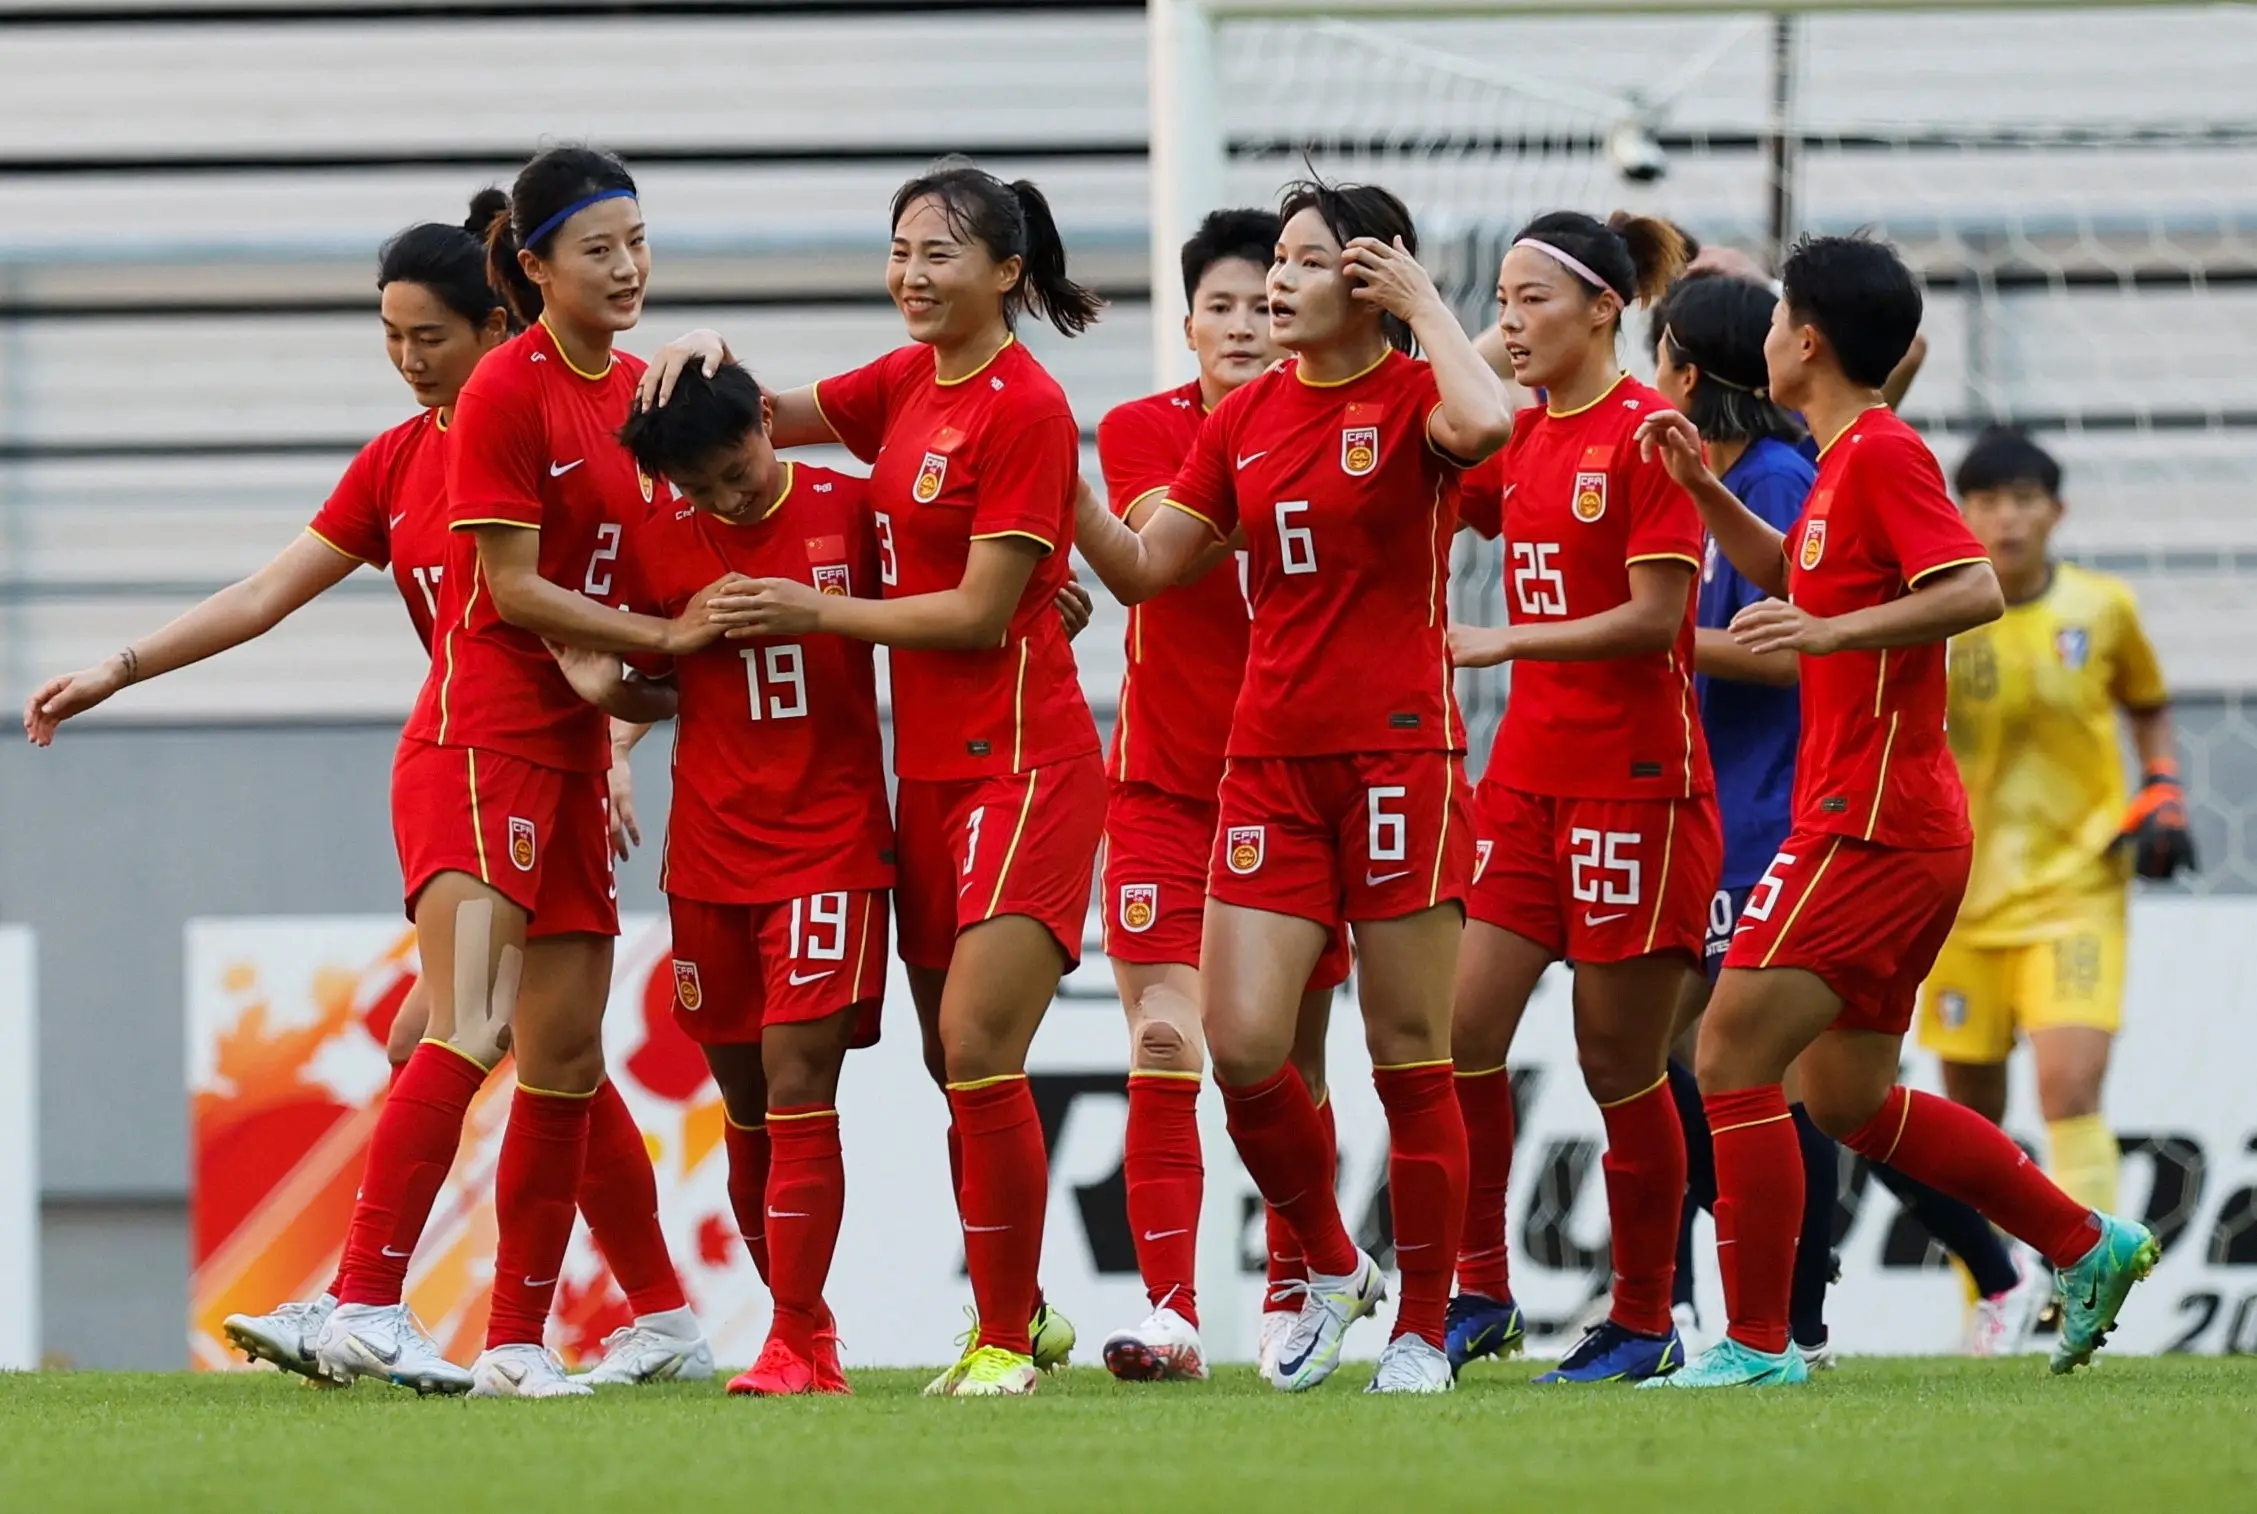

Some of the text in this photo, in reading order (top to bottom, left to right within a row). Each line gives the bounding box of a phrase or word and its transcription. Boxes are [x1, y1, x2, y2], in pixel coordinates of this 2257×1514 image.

[1347, 431, 1373, 442] CFA
[585, 522, 622, 596] 2
[818, 569, 845, 580] CFA
[874, 510, 897, 587] 3
[1275, 500, 1317, 575] 6
[1512, 542, 1568, 616] 25
[739, 644, 808, 721] 19
[1232, 830, 1259, 841] CFA
[1368, 786, 1406, 861] 6
[1126, 888, 1152, 899] CFA
[1570, 827, 1642, 905] 25
[789, 891, 848, 961] 19
